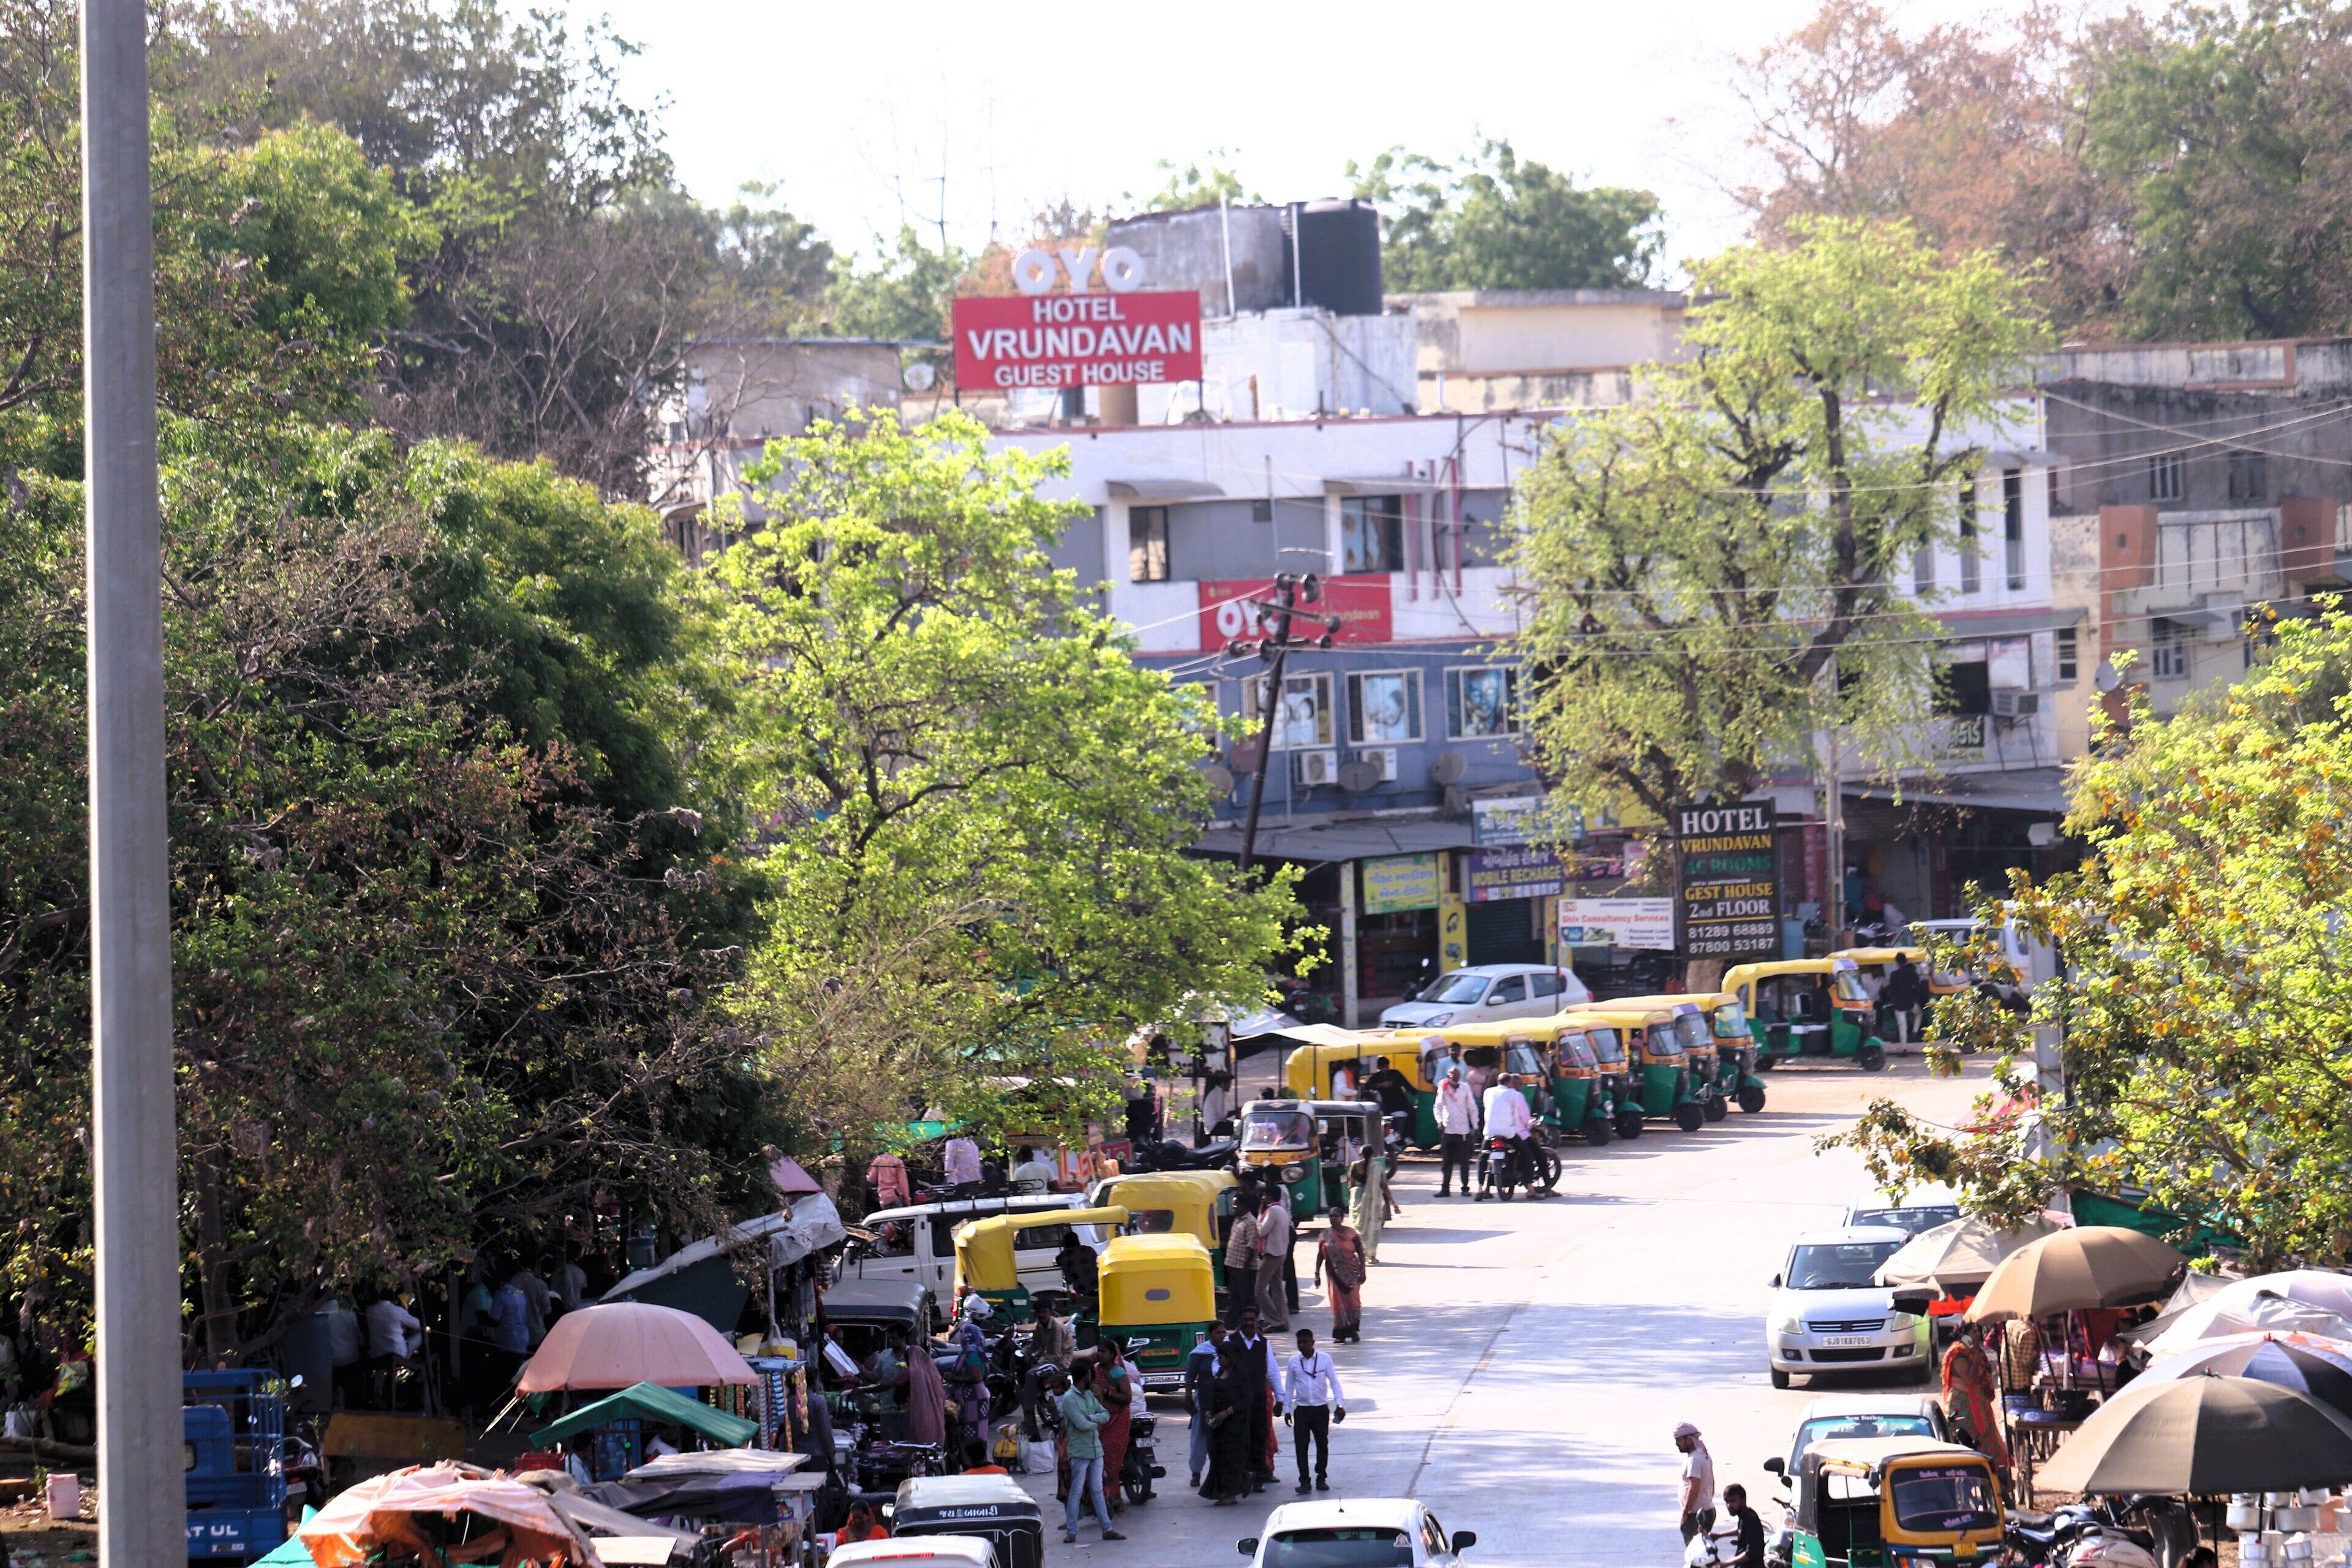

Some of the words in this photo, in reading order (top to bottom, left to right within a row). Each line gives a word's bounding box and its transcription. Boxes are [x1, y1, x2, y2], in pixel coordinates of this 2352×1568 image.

[1012, 246, 1144, 295] OYO
[1033, 297, 1126, 323] HOTEL
[967, 323, 1192, 360] VRUNDAVAN
[994, 364, 1076, 387] GUEST
[1082, 360, 1165, 384] HOUSE
[1681, 807, 1770, 834] HOTEL
[1681, 834, 1772, 853] VRUNDAVAN
[1685, 858, 1706, 874] AC
[1710, 855, 1772, 873] ROOMS
[1471, 870, 1509, 887] MOBILE
[1510, 864, 1562, 883] RECHARGE
[1685, 886, 1722, 901] GEST
[1724, 882, 1774, 899] HOUSE
[1581, 914, 1632, 924] Consultancy
[1634, 914, 1670, 922] Services
[1689, 903, 1713, 918] 2nd
[1716, 899, 1771, 917] FLOOR
[1689, 940, 1730, 954] 87800
[1734, 937, 1775, 951] 53187
